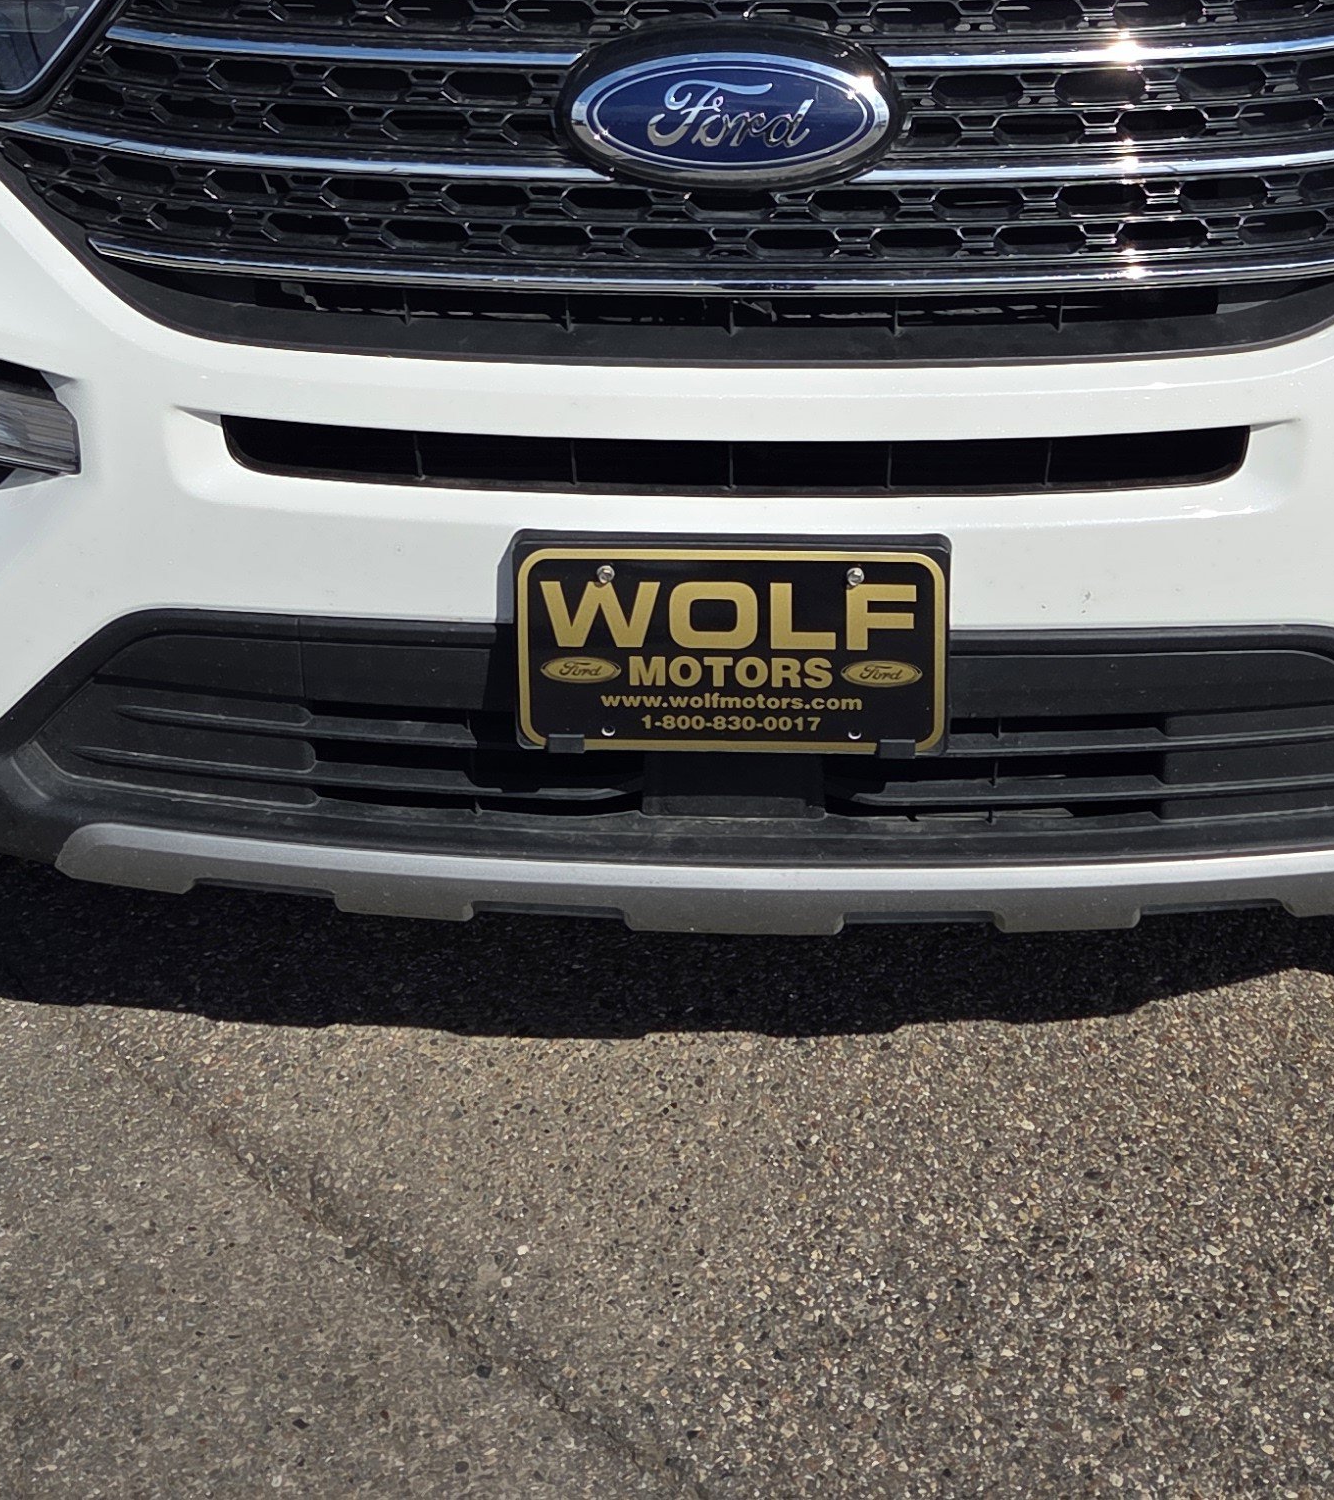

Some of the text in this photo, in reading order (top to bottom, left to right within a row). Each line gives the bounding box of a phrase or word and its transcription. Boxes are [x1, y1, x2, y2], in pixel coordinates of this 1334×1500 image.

[647, 79, 815, 147] Ford
[540, 580, 917, 651] WOLF
[629, 655, 834, 689] MOTORS
[600, 691, 863, 711] www.wolfmotors.com
[641, 714, 822, 732] 1-800-830-0017
